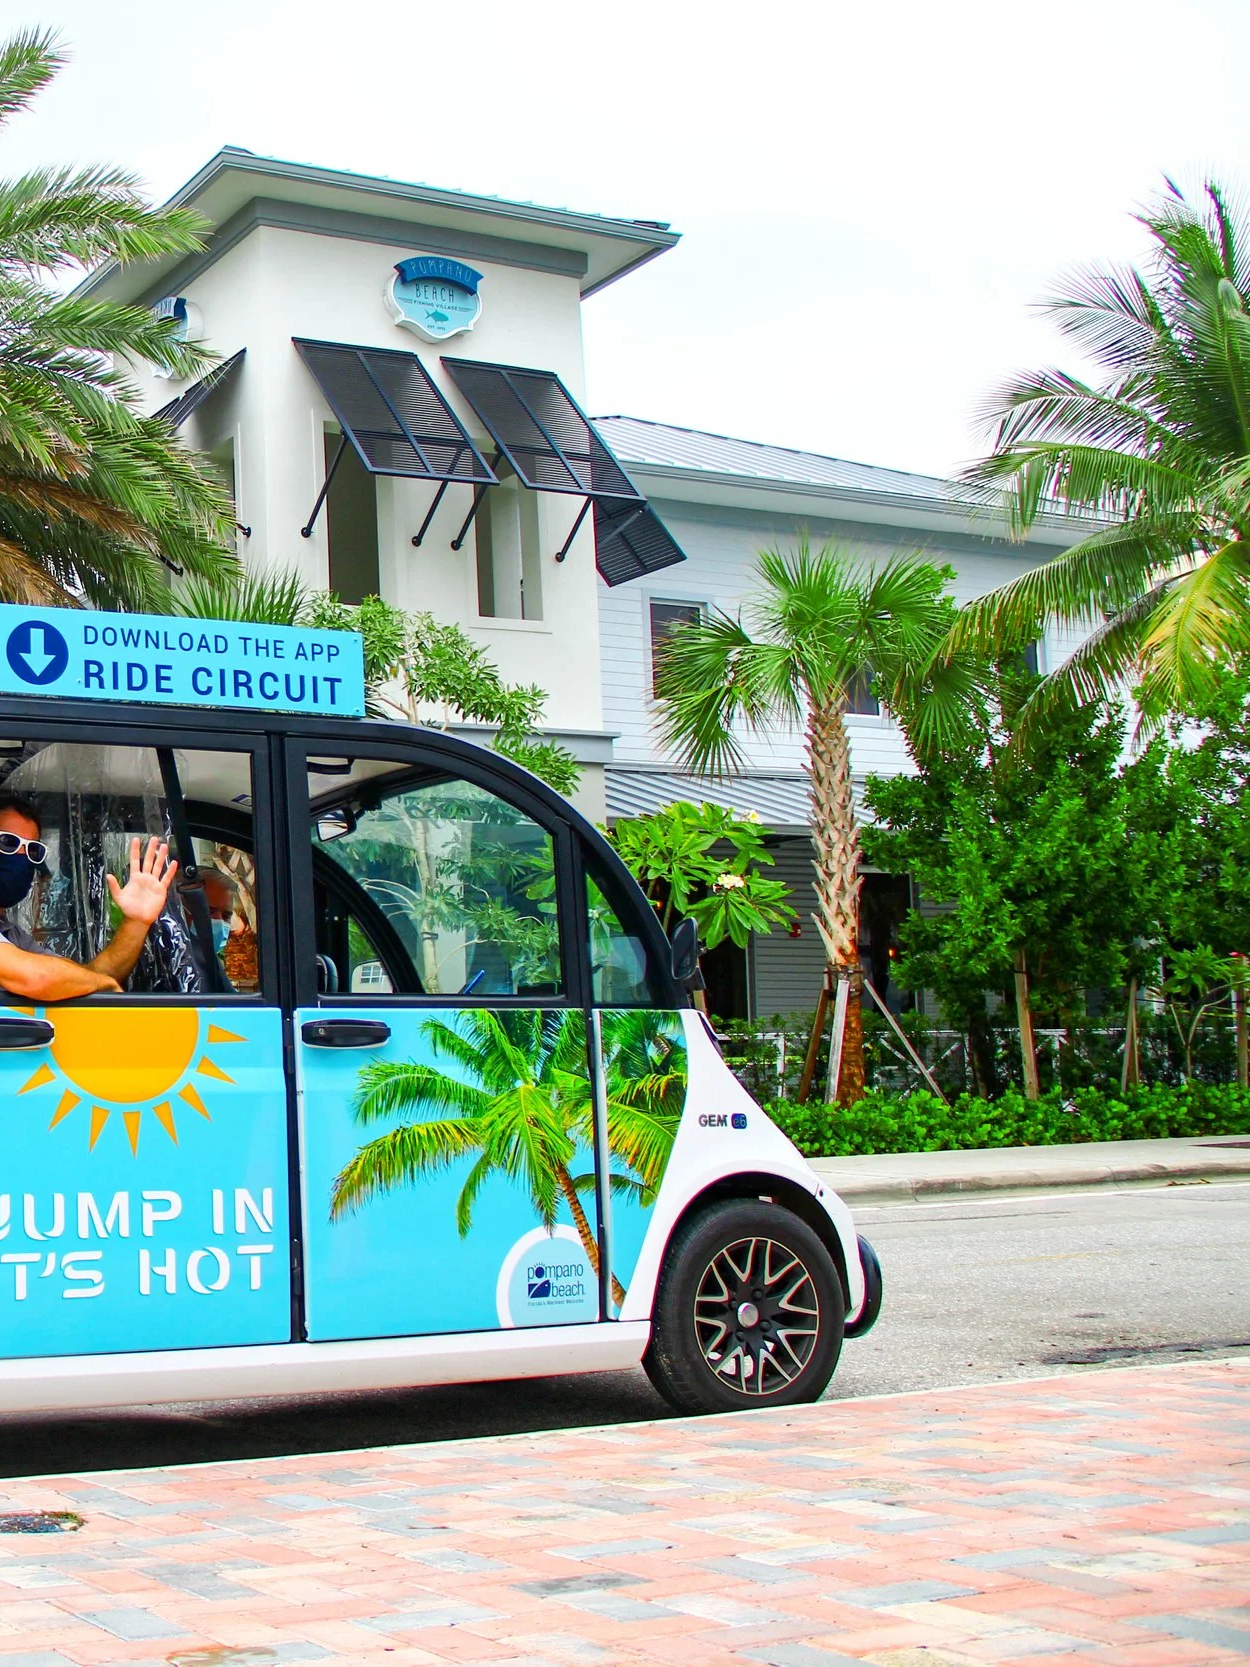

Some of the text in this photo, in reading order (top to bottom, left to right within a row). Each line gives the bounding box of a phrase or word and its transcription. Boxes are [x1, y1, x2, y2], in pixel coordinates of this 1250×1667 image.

[410, 260, 472, 282] POMPANO
[415, 283, 454, 303] BEACH
[83, 625, 340, 663] DOWNLOAD THE APP
[83, 659, 343, 705] RIDE CIRCUIT
[698, 1113, 728, 1128] GEM
[212, 1187, 273, 1235] IN
[138, 1244, 274, 1295] HOT
[527, 1263, 584, 1282] pompano
[551, 1280, 585, 1297] beach
